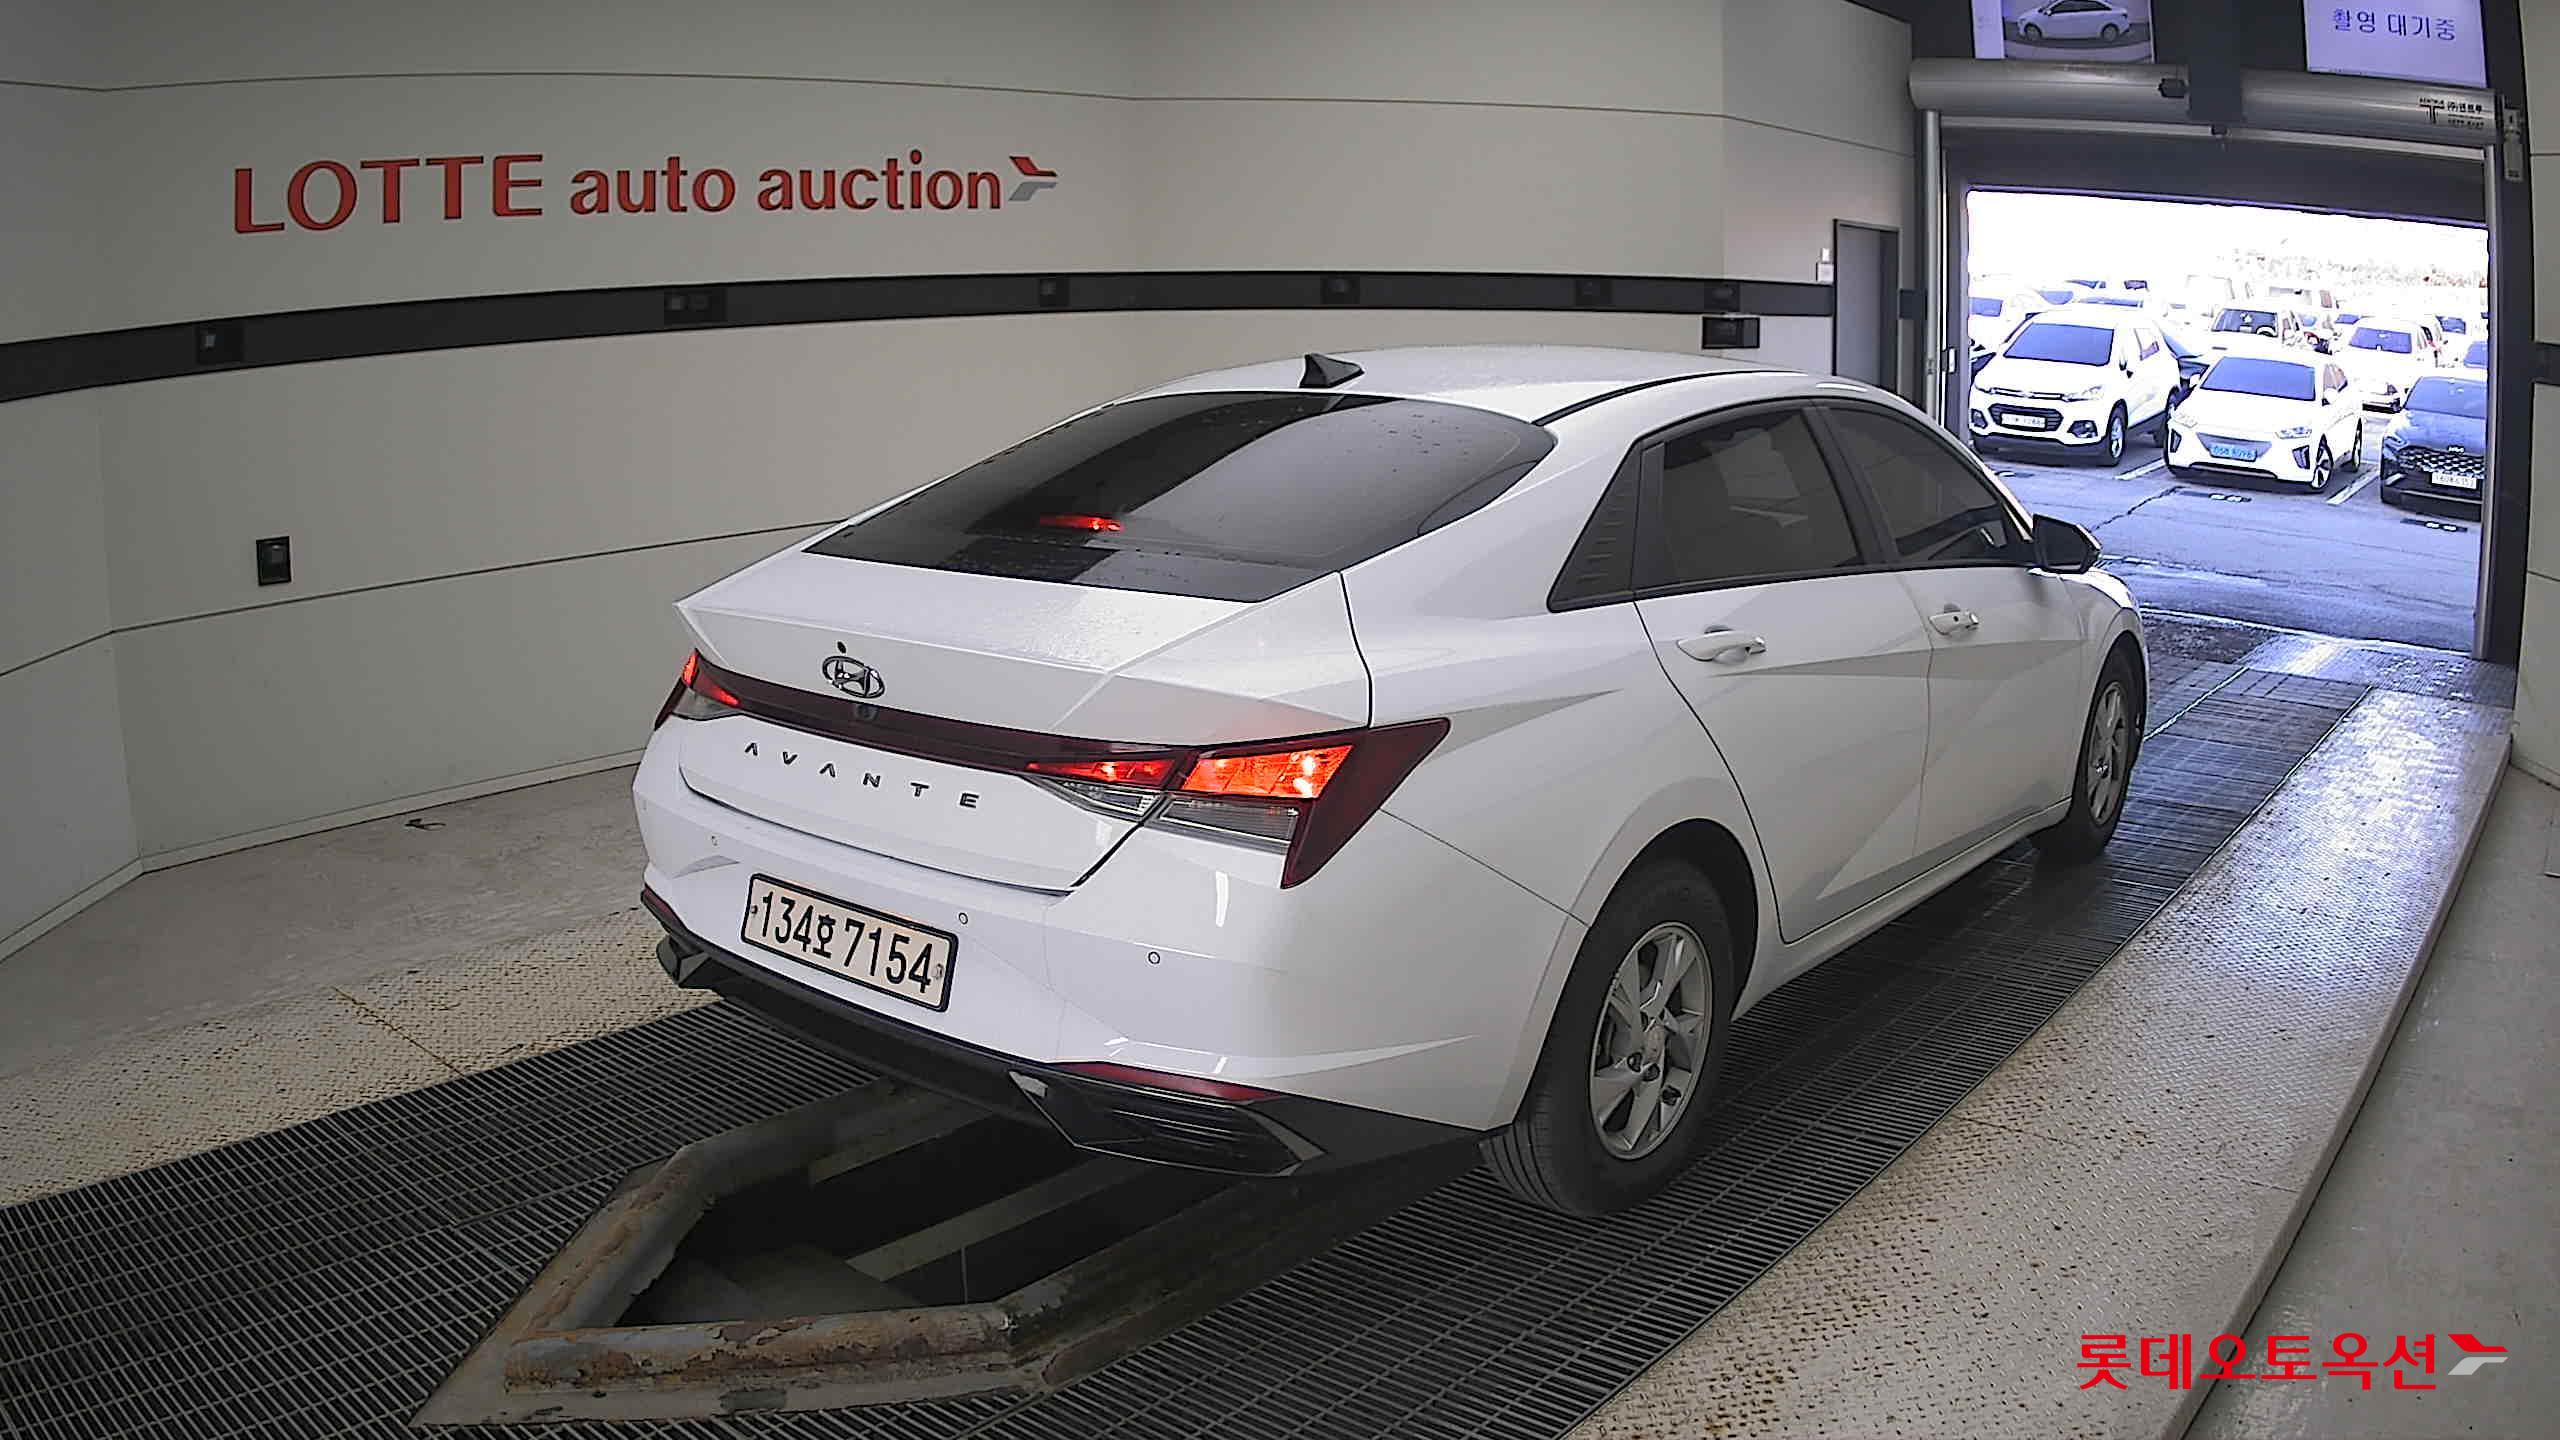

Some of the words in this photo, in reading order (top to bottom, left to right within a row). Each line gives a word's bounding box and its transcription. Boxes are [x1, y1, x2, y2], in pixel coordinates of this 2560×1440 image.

[233, 153, 543, 234] LOTTE
[569, 155, 737, 215] auto
[756, 149, 1001, 213] auction
[744, 741, 980, 808] AVANTE
